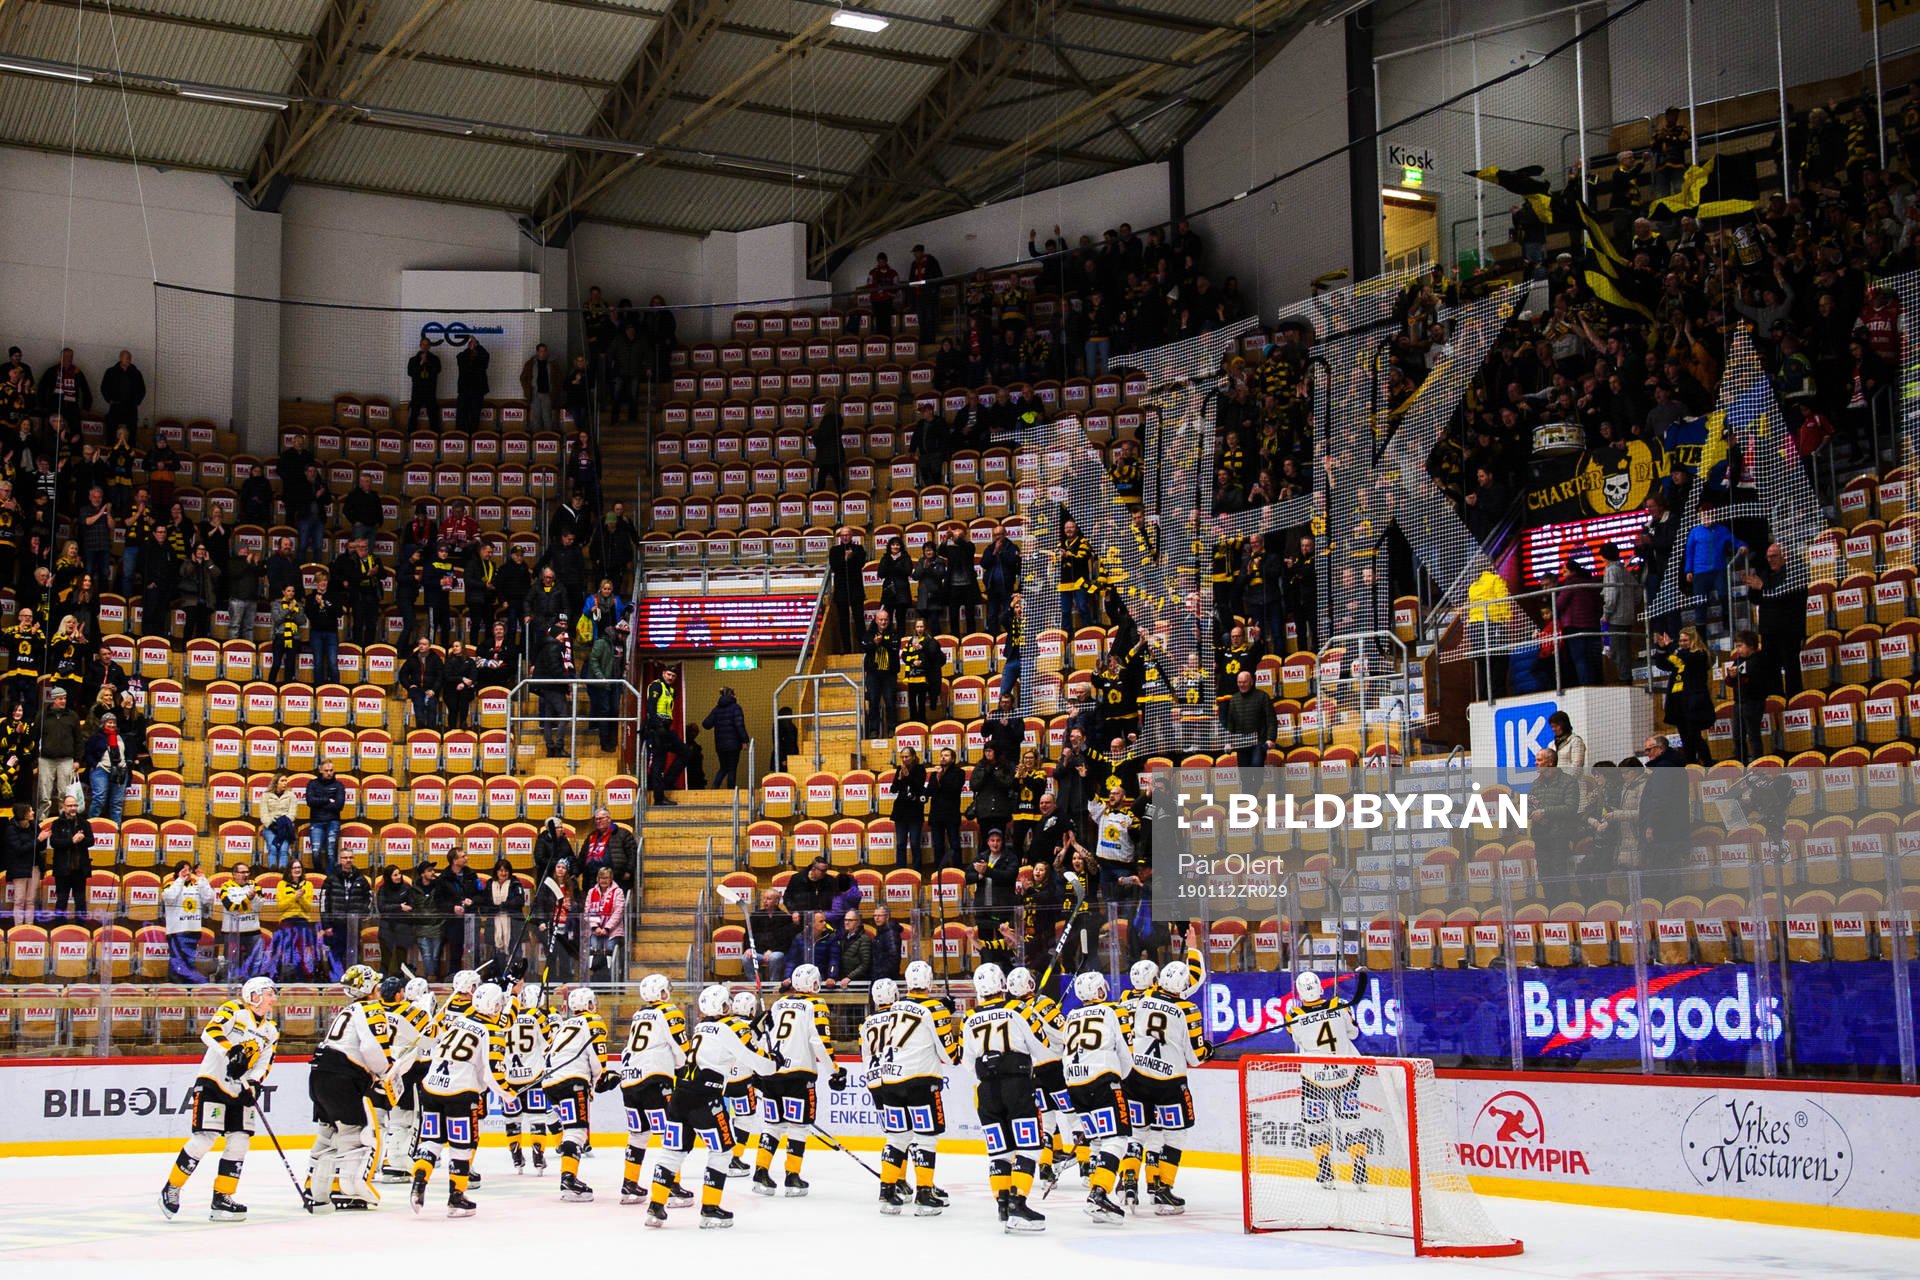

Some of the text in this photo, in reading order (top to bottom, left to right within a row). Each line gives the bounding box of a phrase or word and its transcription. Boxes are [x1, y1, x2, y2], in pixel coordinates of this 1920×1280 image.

[1389, 146, 1434, 170] Kiosk
[1095, 386, 1117, 395] MAXI
[984, 458, 1005, 468] MAXI
[1527, 471, 1603, 511] CHARTER
[1841, 496, 1865, 507] MAXI
[971, 531, 992, 539] MAXI
[1846, 543, 1870, 552] MAXI
[100, 609, 123, 617] MAXI
[1075, 644, 1094, 652] MAXI
[372, 659, 393, 667] MAXI
[1283, 670, 1305, 679] MAXI
[156, 695, 178, 703] MAXI
[212, 697, 235, 705] MAXI
[358, 701, 381, 709] MAXI
[1825, 711, 1851, 721] MAXI
[1866, 706, 1892, 716] MAXI
[1784, 717, 1808, 725] MAXI
[213, 743, 239, 751] MAXI
[898, 739, 919, 747] MAXI
[326, 746, 349, 754] MAXI
[449, 746, 471, 754] MAXI
[155, 788, 178, 796] MAXI
[767, 790, 788, 798] MAXI
[168, 839, 191, 847] MAXI
[227, 840, 250, 848] MAXI
[386, 842, 410, 850] MAXI
[751, 839, 773, 847] MAXI
[888, 889, 910, 897] MAXI
[1658, 924, 1685, 936] MAXI
[1788, 920, 1819, 931] MAXI
[1833, 920, 1861, 930] MAXI
[1055, 923, 1072, 953] CCM
[1544, 928, 1569, 939] MAXI
[1209, 938, 1233, 948] MAXI
[1255, 938, 1276, 947] MAXI
[1368, 935, 1391, 944] MAXI
[17, 946, 42, 955] MAXI
[60, 946, 82, 955] MAXI
[716, 946, 739, 955] MAXI
[1141, 1001, 1182, 1018] BOLIDEN
[967, 1011, 1013, 1027] BOLIDEN
[1523, 973, 1782, 1058] Bussgods
[506, 1025, 534, 1054] 45
[972, 1021, 1010, 1054] 71
[1066, 1017, 1104, 1056] 25
[1316, 1020, 1337, 1053] 4
[440, 1028, 479, 1061] 46
[1133, 1055, 1174, 1075] GRANBERG
[508, 1067, 533, 1078] MÖLLER
[807, 1088, 816, 1120] REPAY
[830, 1092, 856, 1106] DET
[1113, 1087, 1129, 1126] REPAY
[1727, 1099, 1790, 1145] Yrkes
[716, 1111, 733, 1146] REPAY
[1447, 1142, 1590, 1176] PROLYMPIA
[1702, 1142, 1840, 1184] Mästaren
